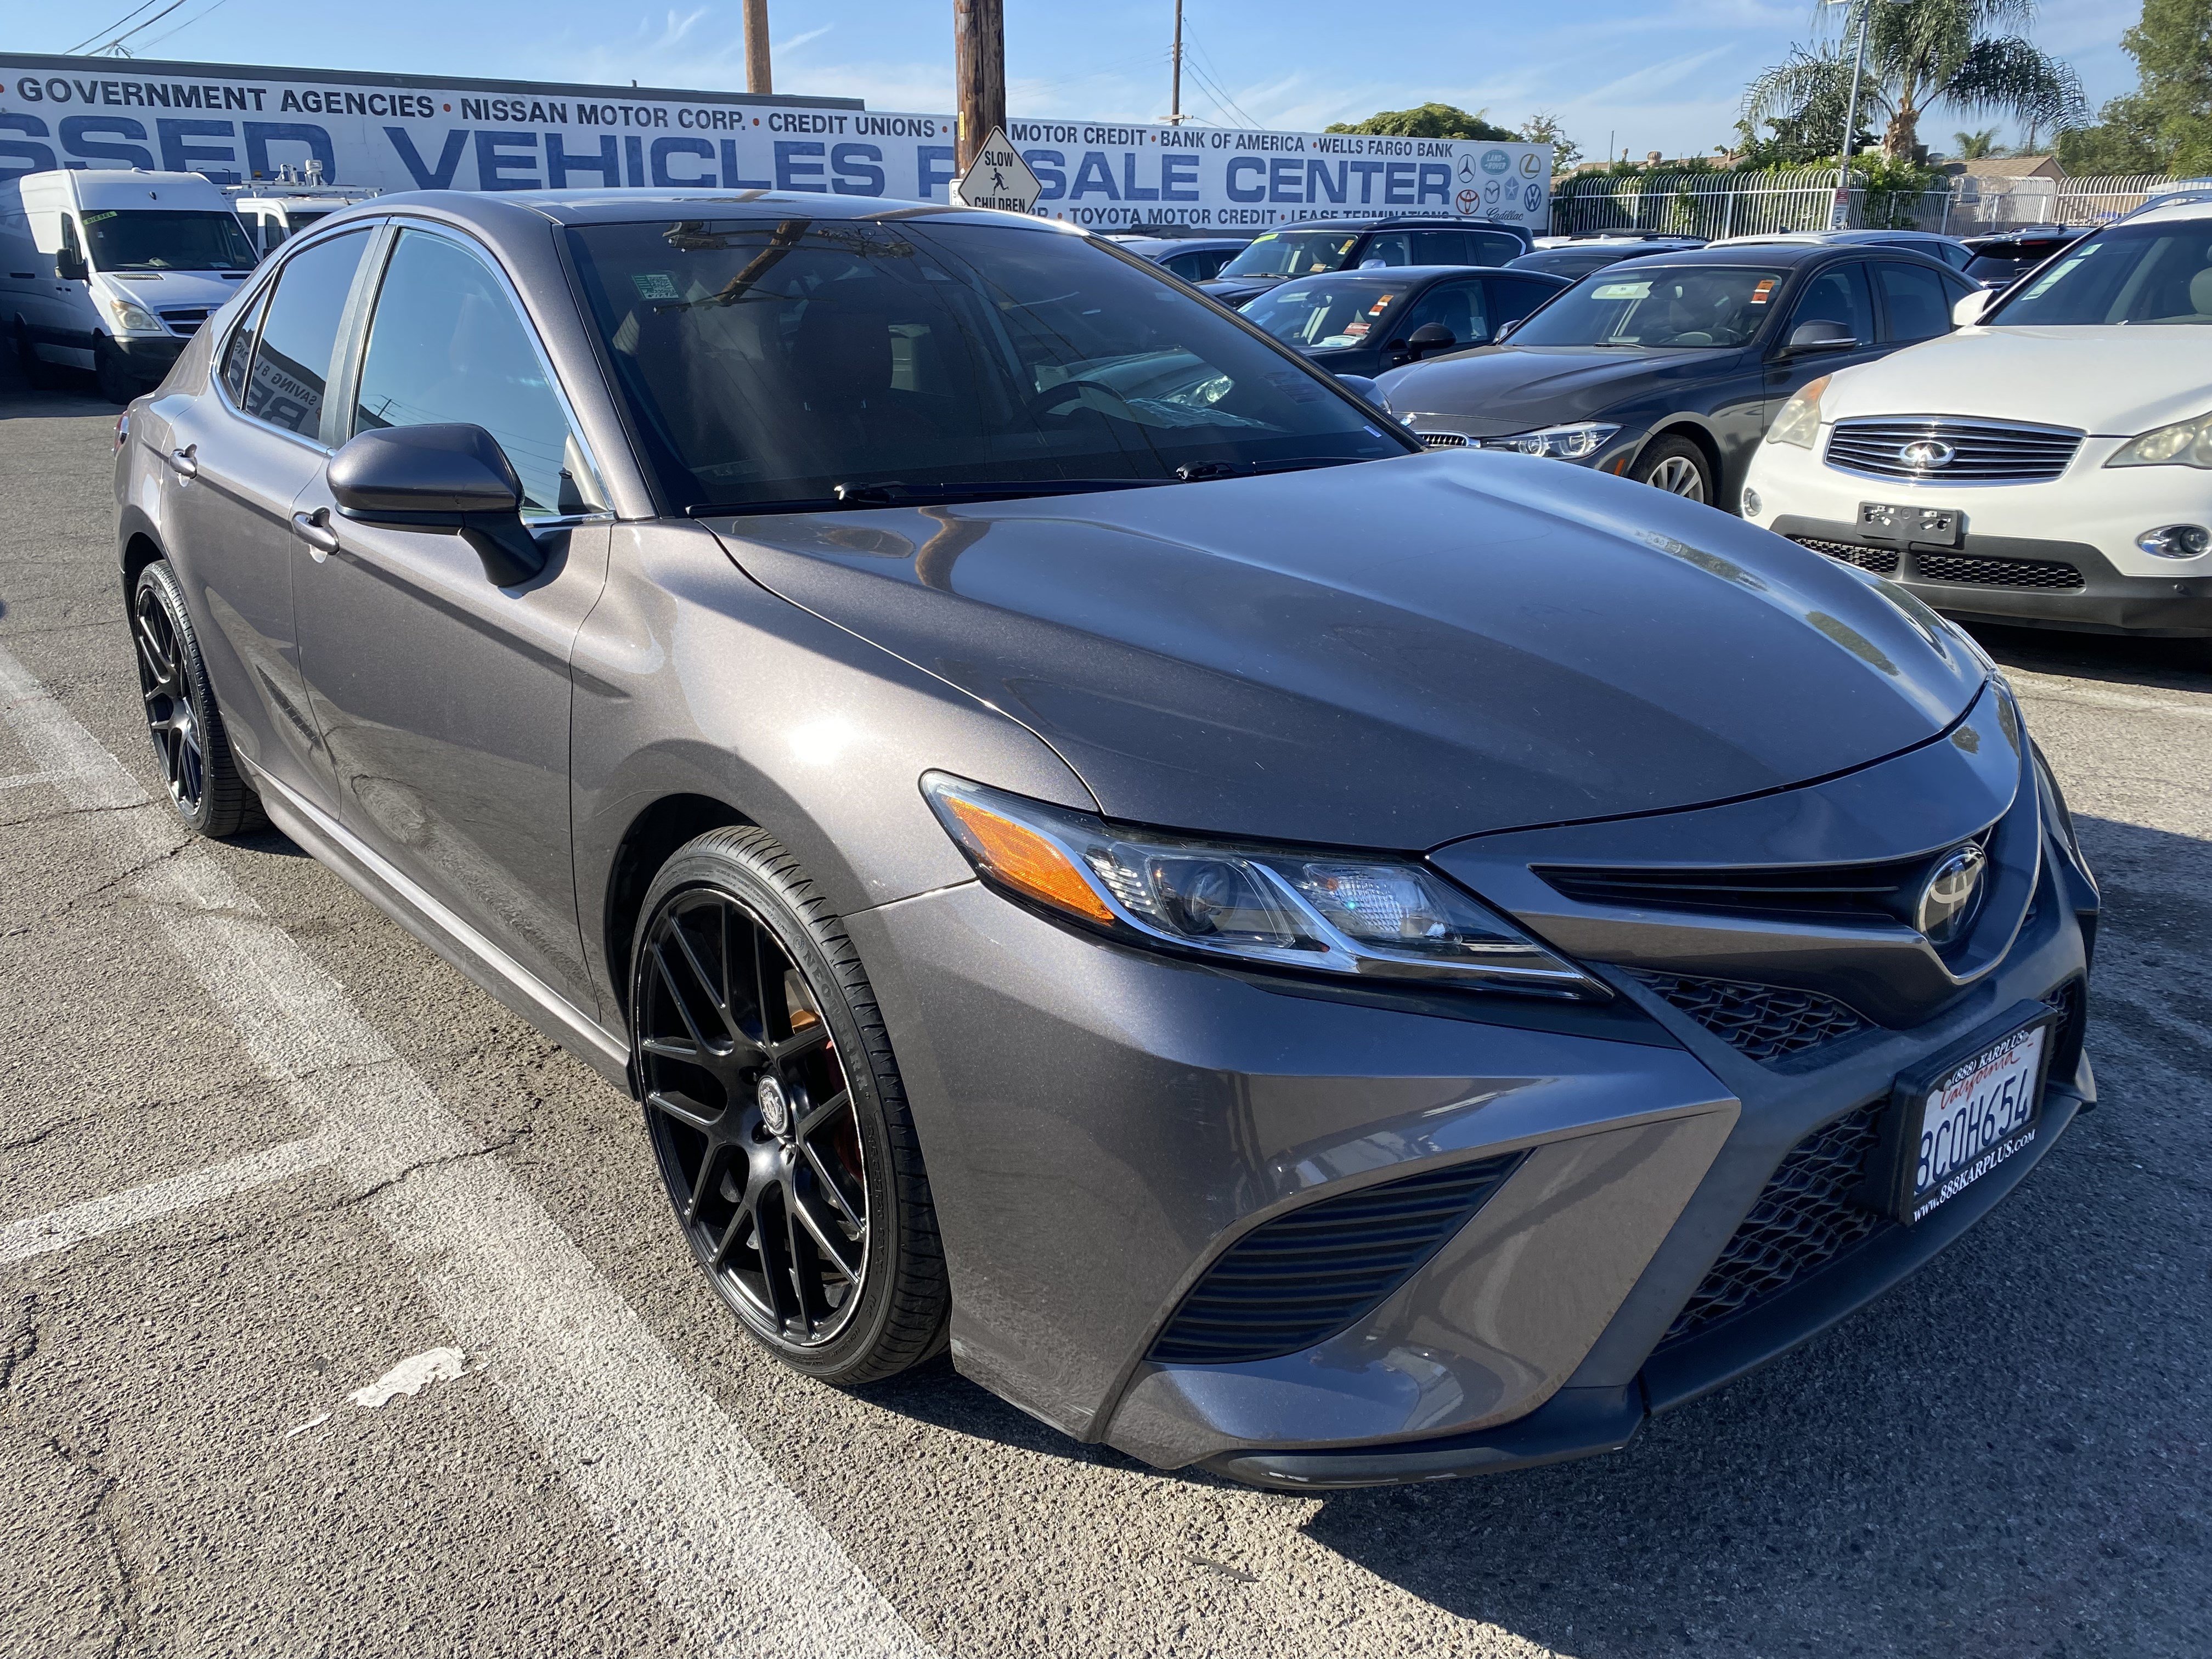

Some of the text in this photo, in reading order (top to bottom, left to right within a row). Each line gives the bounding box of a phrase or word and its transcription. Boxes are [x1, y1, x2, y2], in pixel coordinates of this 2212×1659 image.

[16, 77, 434, 119] GOVERNMENT AGENCIES
[461, 98, 746, 131] NISSAN MOTOR CORP.
[768, 113, 848, 136] CREDIT
[855, 116, 935, 138] UNIONS
[1011, 123, 1147, 147] MOTOR CREDIT
[1160, 130, 1305, 153] BANK OF AMERICA
[984, 150, 1014, 167] SLOW
[1319, 138, 1454, 158] WELLS FARGO BANK
[382, 127, 885, 196] VEHICLES
[1226, 156, 1451, 205] CENTER
[974, 196, 1026, 213] CHILDREN
[1069, 207, 1277, 225] TOYOTA MOTOR CREDIT
[1486, 207, 1524, 221] Cadillac
[1951, 1059, 1977, 1085] (888)
